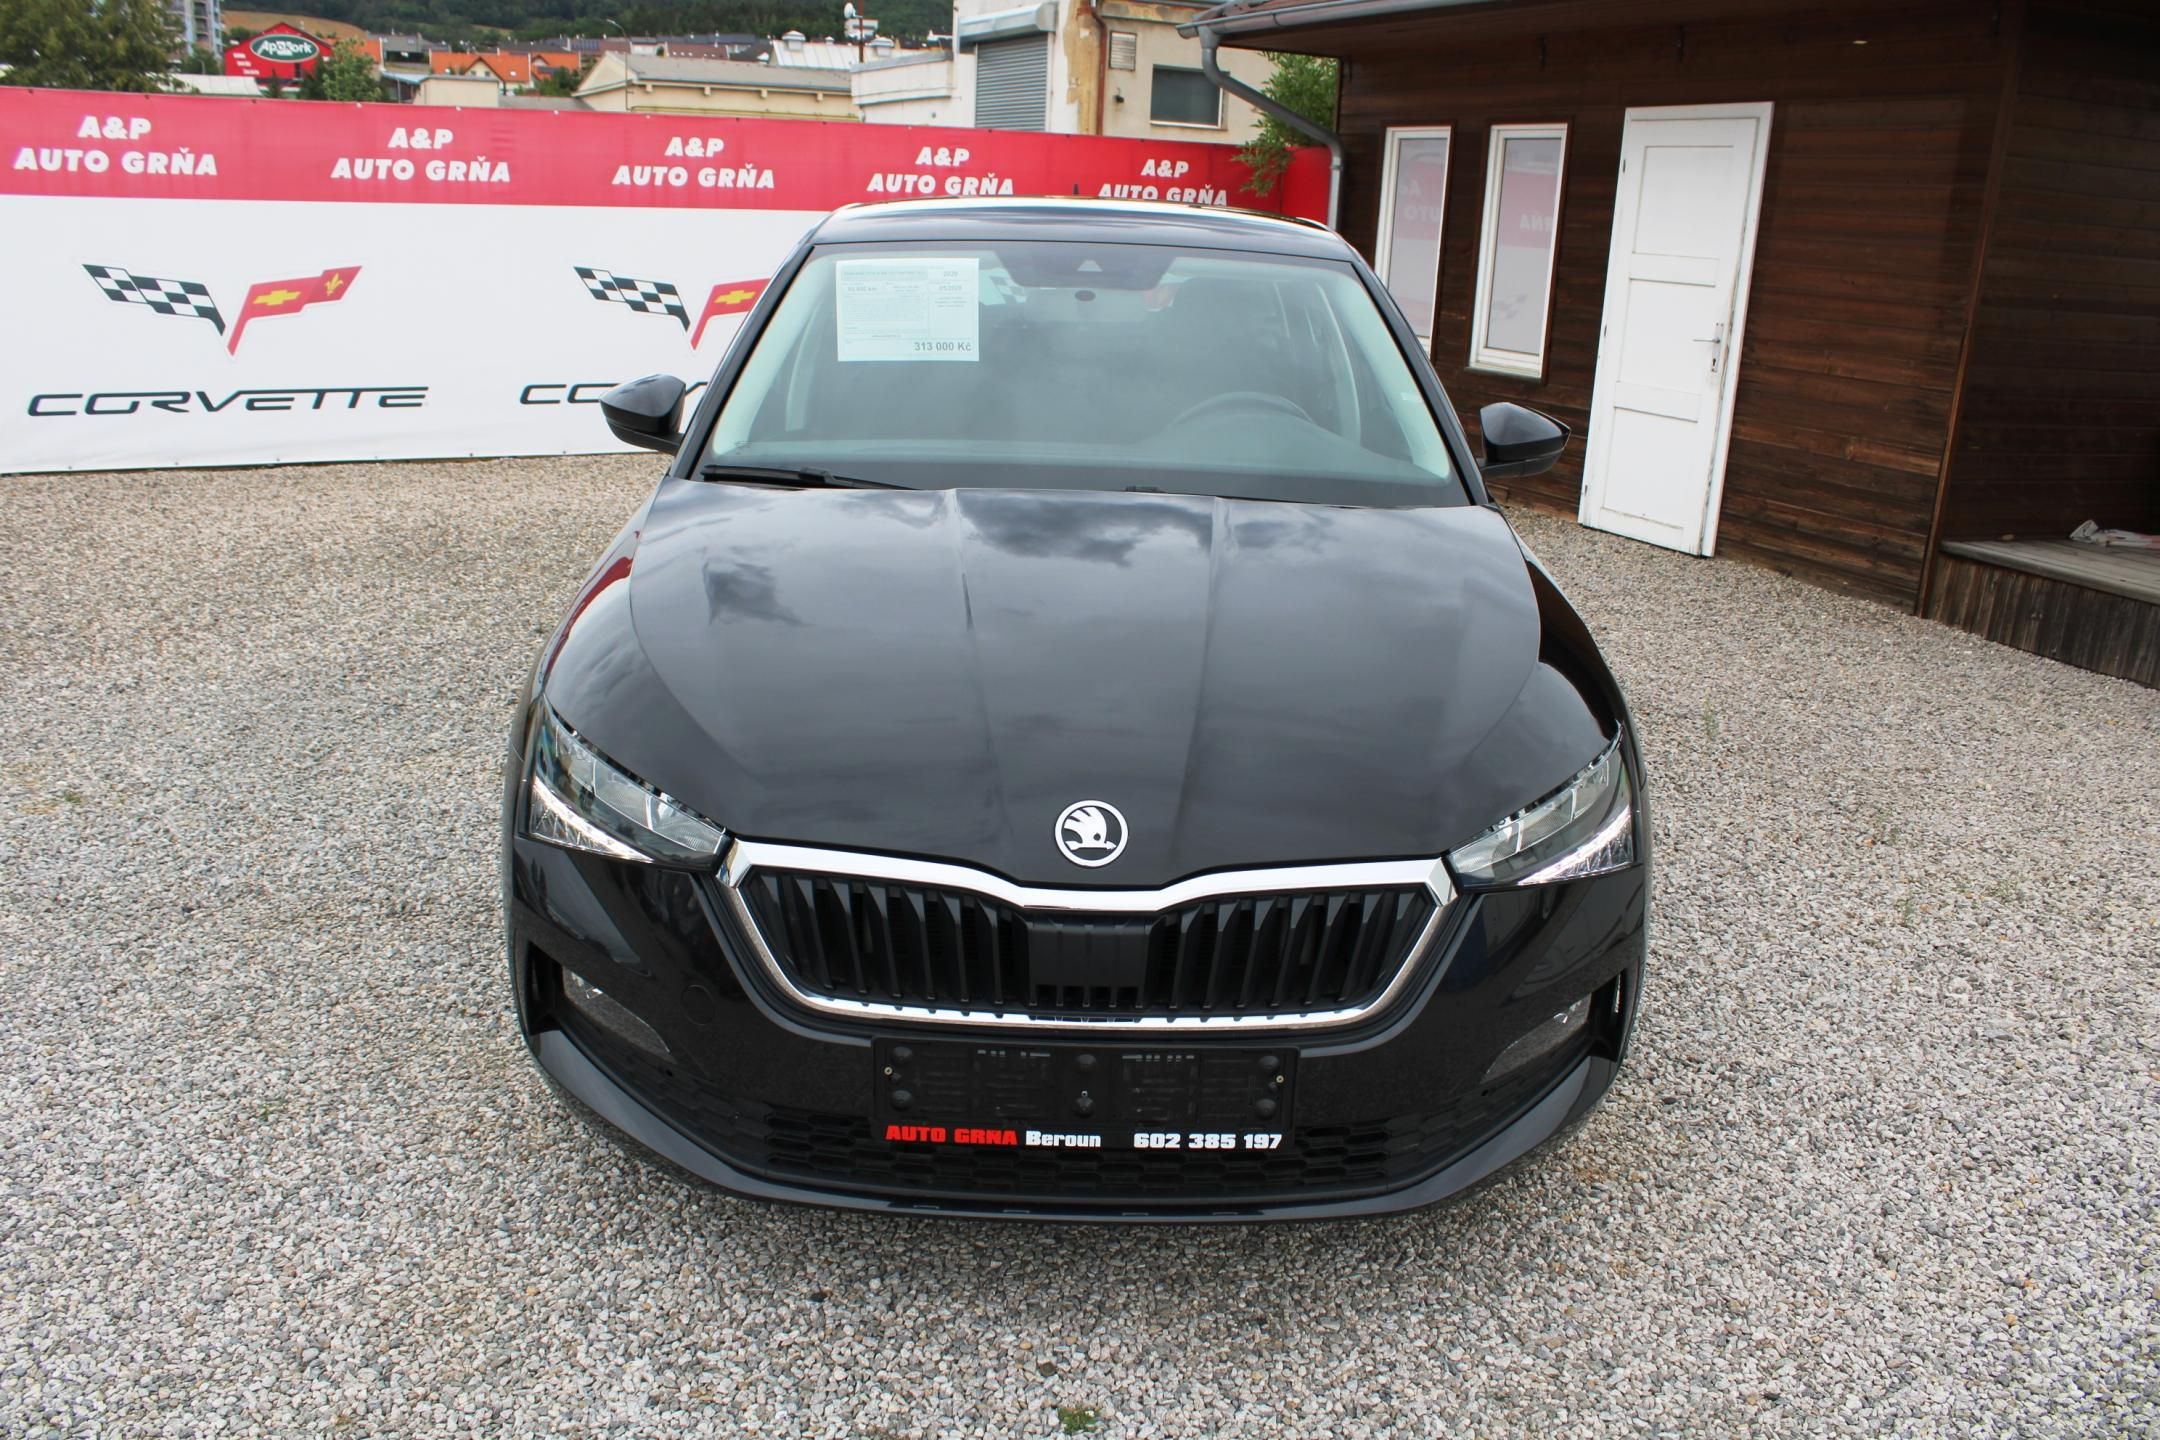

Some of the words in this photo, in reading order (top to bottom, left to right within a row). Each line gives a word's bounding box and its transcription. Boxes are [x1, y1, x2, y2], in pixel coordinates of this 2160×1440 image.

[77, 115, 152, 141] A&P
[387, 127, 454, 150] A&P
[664, 136, 725, 158] A&P
[915, 146, 970, 167] A&P
[13, 147, 110, 173] AUTO
[121, 147, 218, 176] GRŇA
[330, 157, 415, 181] AUTO
[425, 155, 511, 183] GRŇA
[1141, 159, 1189, 178] A&P
[611, 165, 689, 187] AUTO
[697, 163, 775, 189] GRŇA
[866, 173, 936, 194] AUTO
[945, 172, 1014, 196] GRŇA
[1098, 183, 1158, 201] AUTO
[1166, 184, 1227, 206] GRŇA
[914, 341, 933, 352] 313
[935, 341, 955, 352] 000
[957, 340, 972, 352] Kč
[27, 386, 430, 417] CORVETTE
[885, 1124, 946, 1144] AUTO
[1025, 1130, 1101, 1148] Beroun
[1133, 1132, 1181, 1149] 602
[1188, 1133, 1237, 1150] 385
[1244, 1133, 1283, 1150] 197
